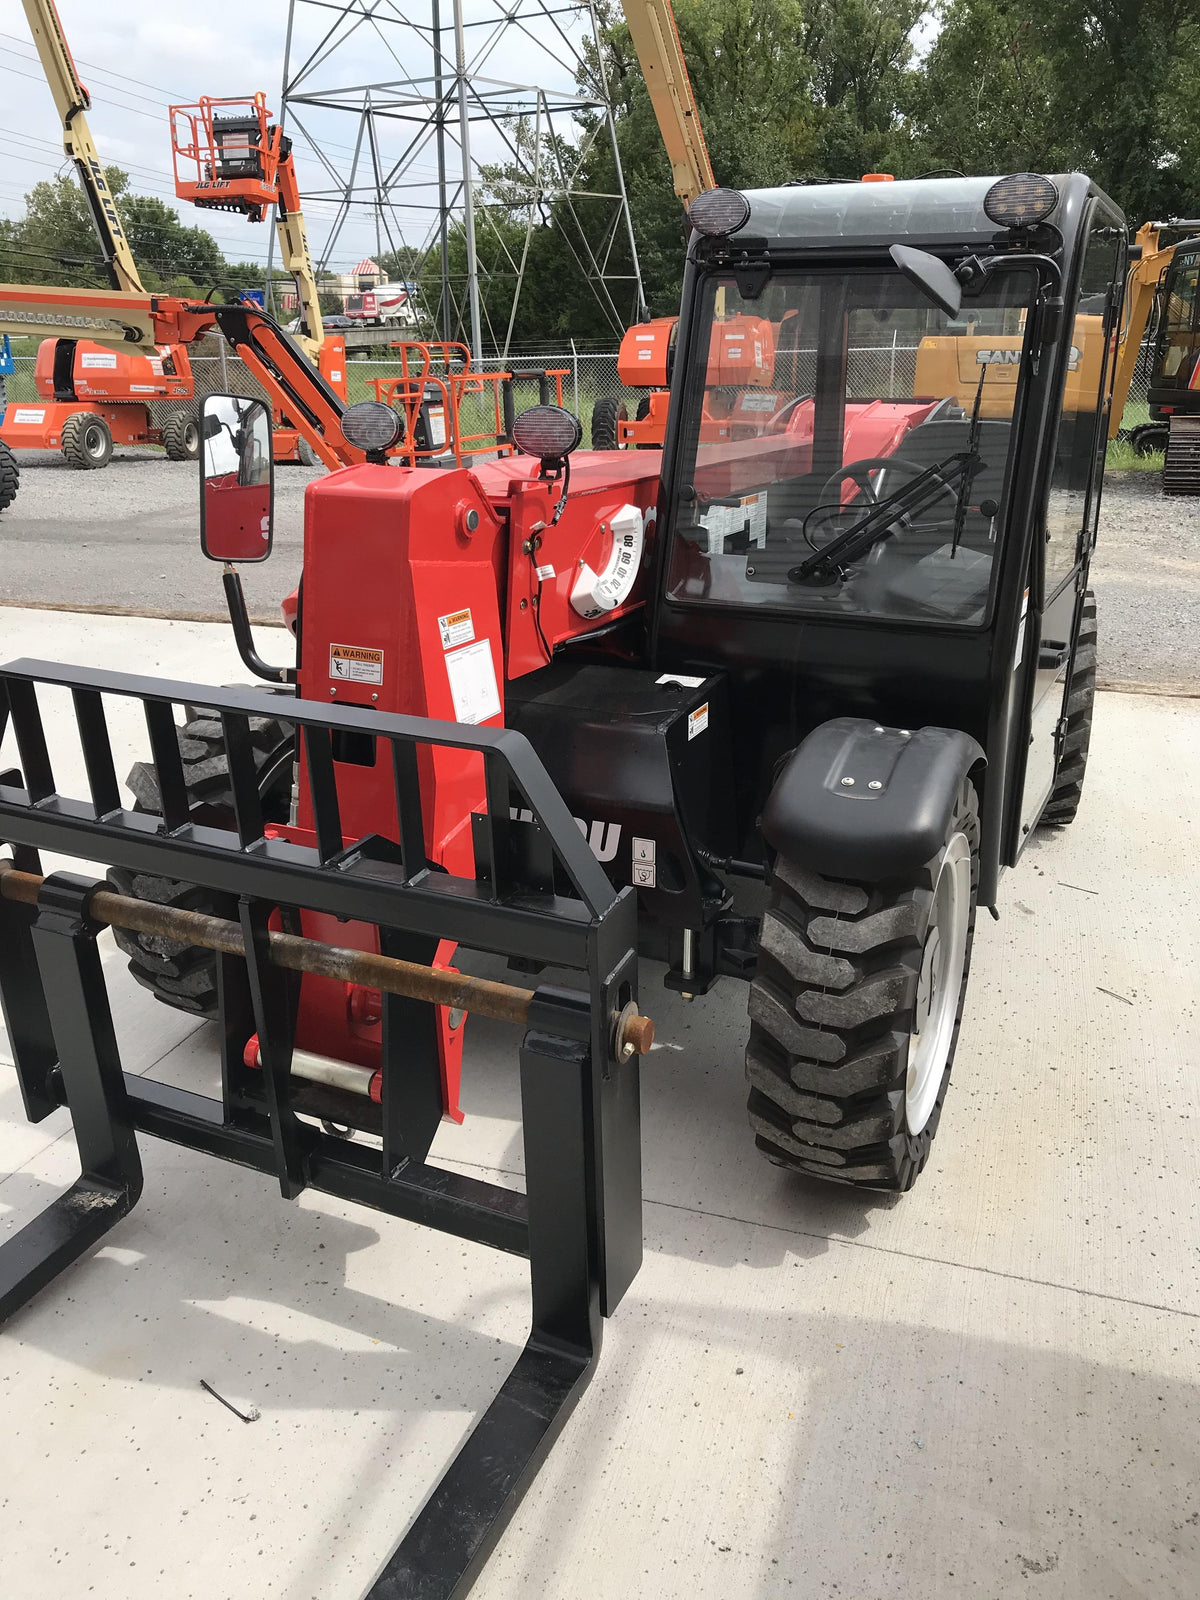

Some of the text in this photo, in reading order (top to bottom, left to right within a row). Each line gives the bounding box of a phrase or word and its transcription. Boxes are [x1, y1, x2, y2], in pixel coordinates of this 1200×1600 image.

[195, 181, 210, 189] JLG
[87, 156, 123, 238] JLG LIFT
[624, 534, 634, 548] 80
[621, 551, 632, 565] 60
[342, 649, 380, 661] WARNING
